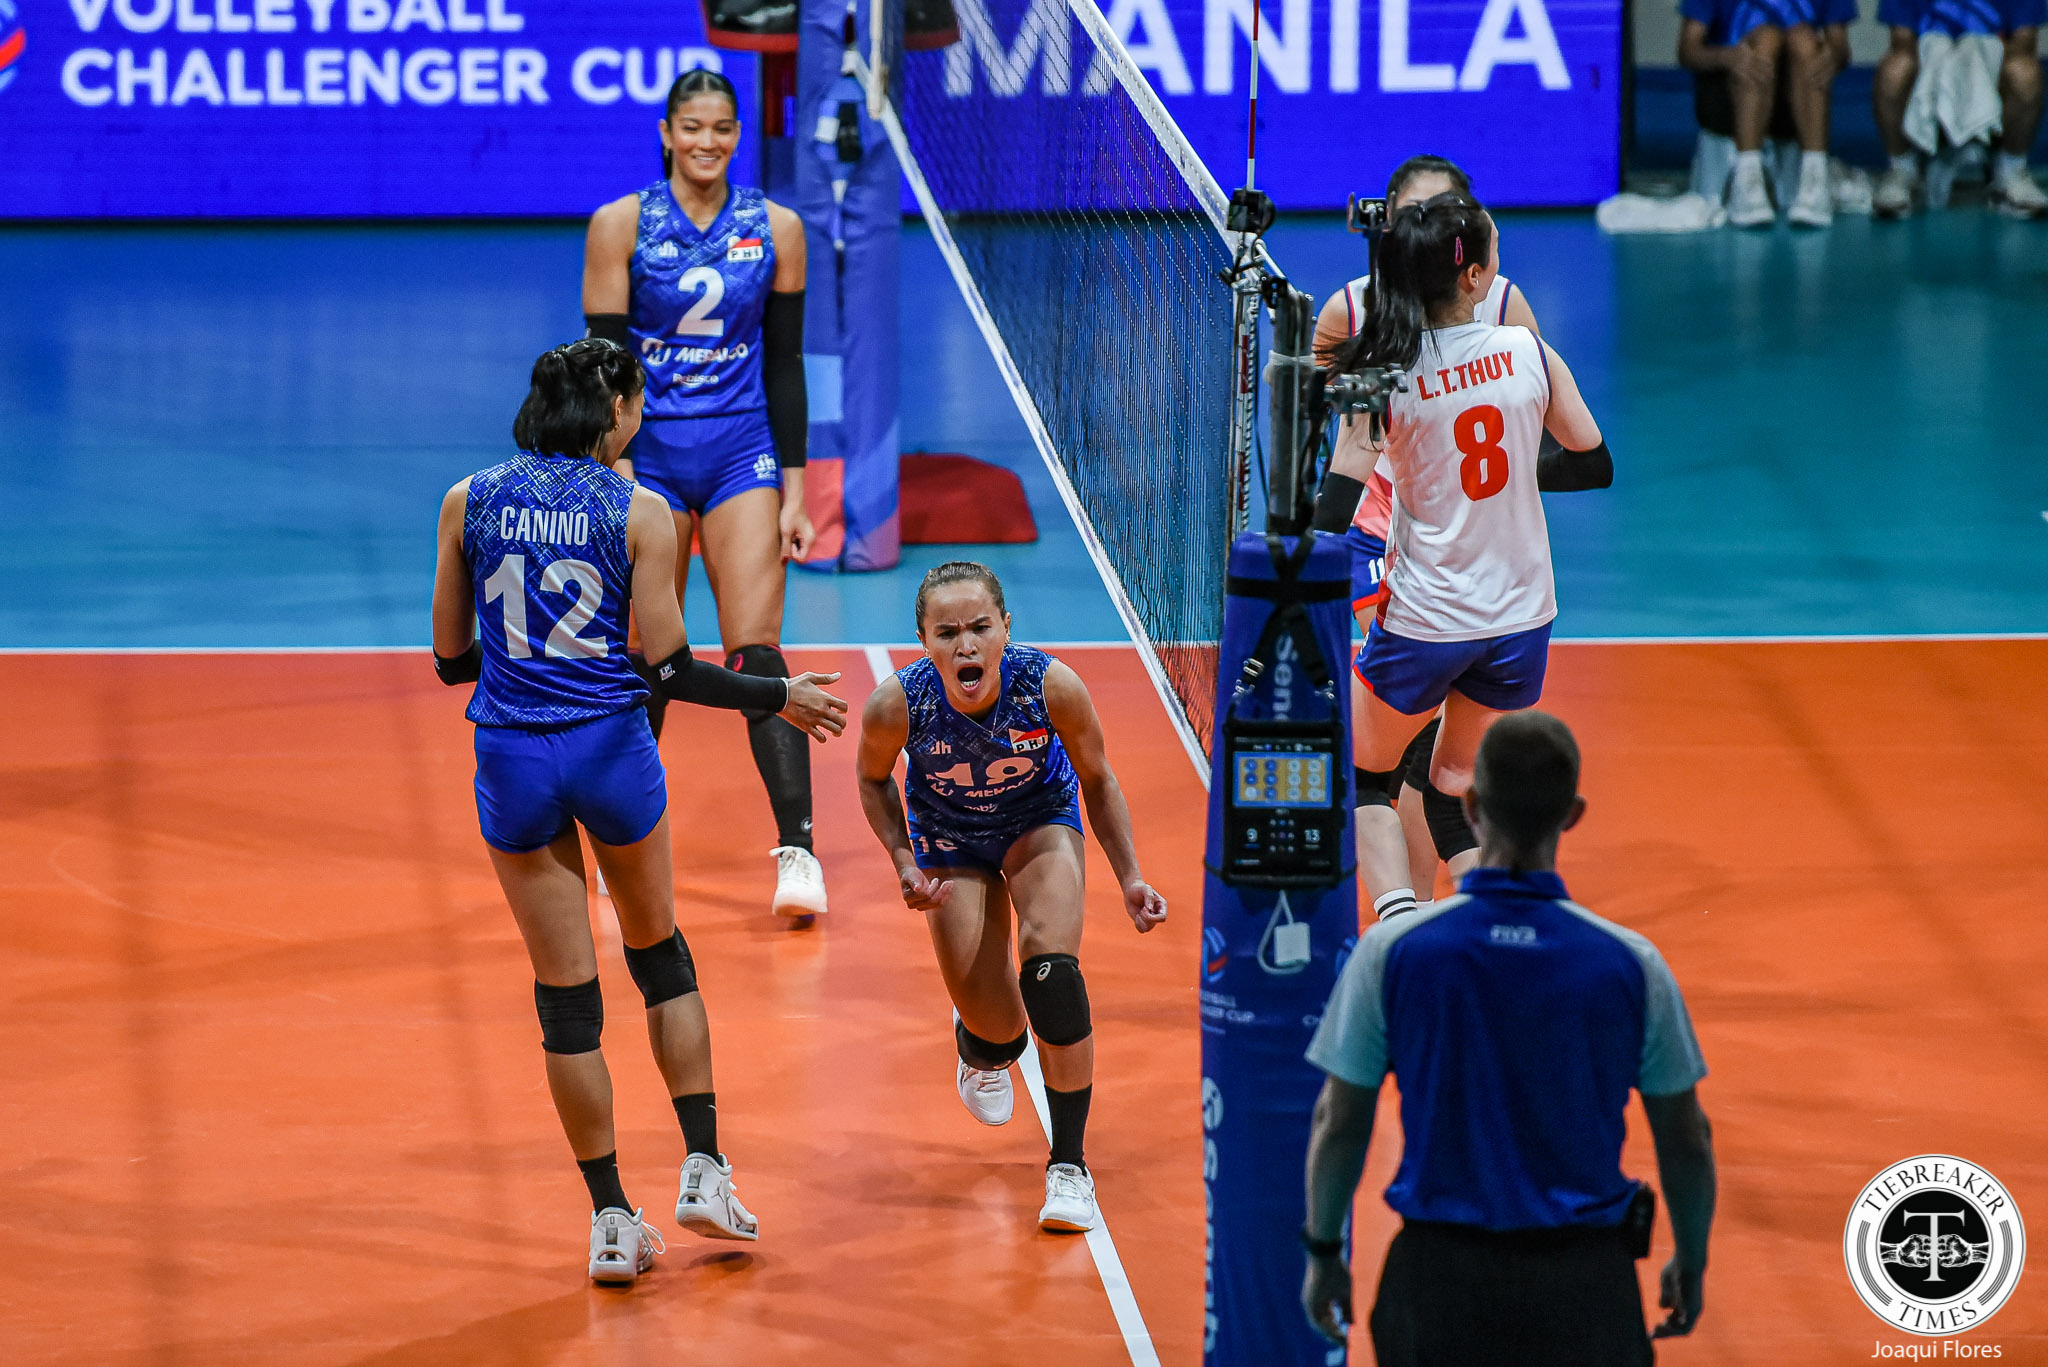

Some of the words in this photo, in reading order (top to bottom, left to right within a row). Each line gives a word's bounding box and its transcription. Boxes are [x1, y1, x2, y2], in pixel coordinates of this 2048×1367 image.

[68, 0, 524, 33] VOLLEYBALL
[943, 0, 1572, 94] MANILA
[61, 48, 552, 106] CHALLENGER
[731, 249, 761, 259] PHI
[676, 266, 726, 337] 2
[1416, 350, 1515, 401] L.T.THUY
[1453, 403, 1510, 502] 8
[500, 505, 590, 547] CANINO
[484, 553, 610, 660] 12
[1273, 631, 1294, 720] Sen
[1016, 736, 1046, 752] PHI
